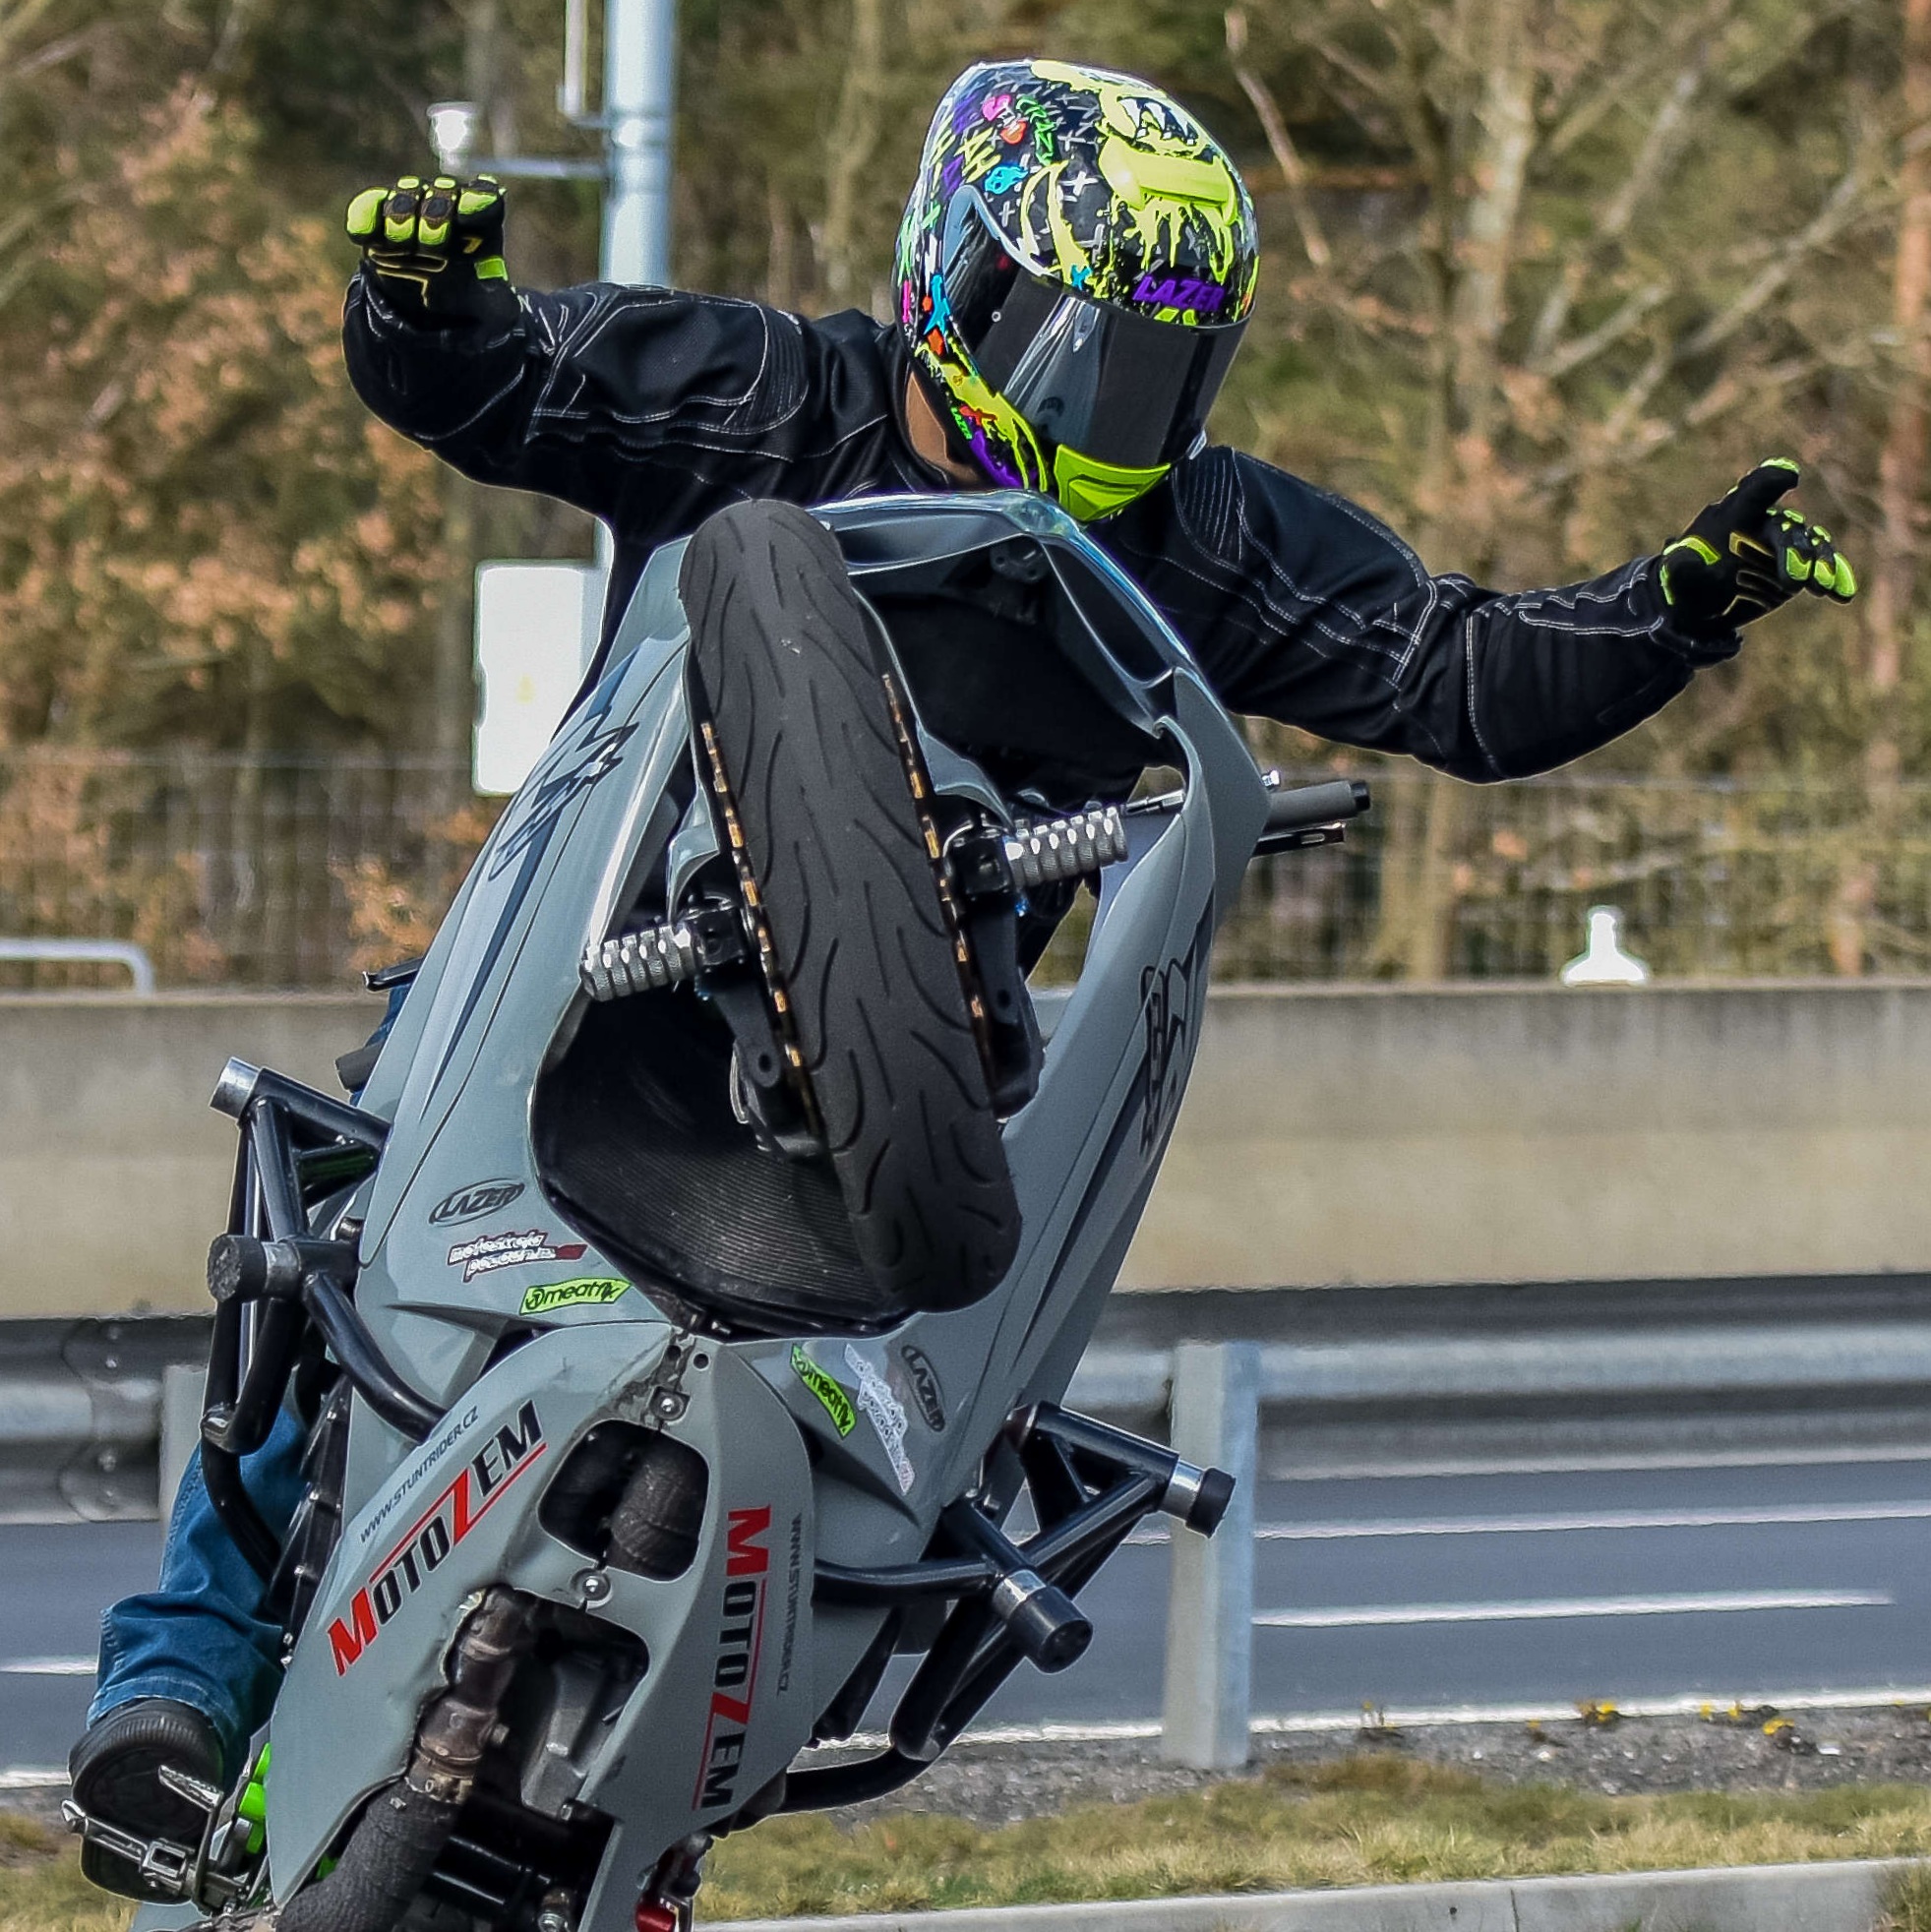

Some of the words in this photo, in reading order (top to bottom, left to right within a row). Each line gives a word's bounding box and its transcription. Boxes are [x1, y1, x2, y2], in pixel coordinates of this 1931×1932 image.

[1132, 275, 1225, 312] LAZER
[440, 1184, 520, 1219] LAZER
[359, 1405, 479, 1544] WWW.STUNTRIDER.CZ
